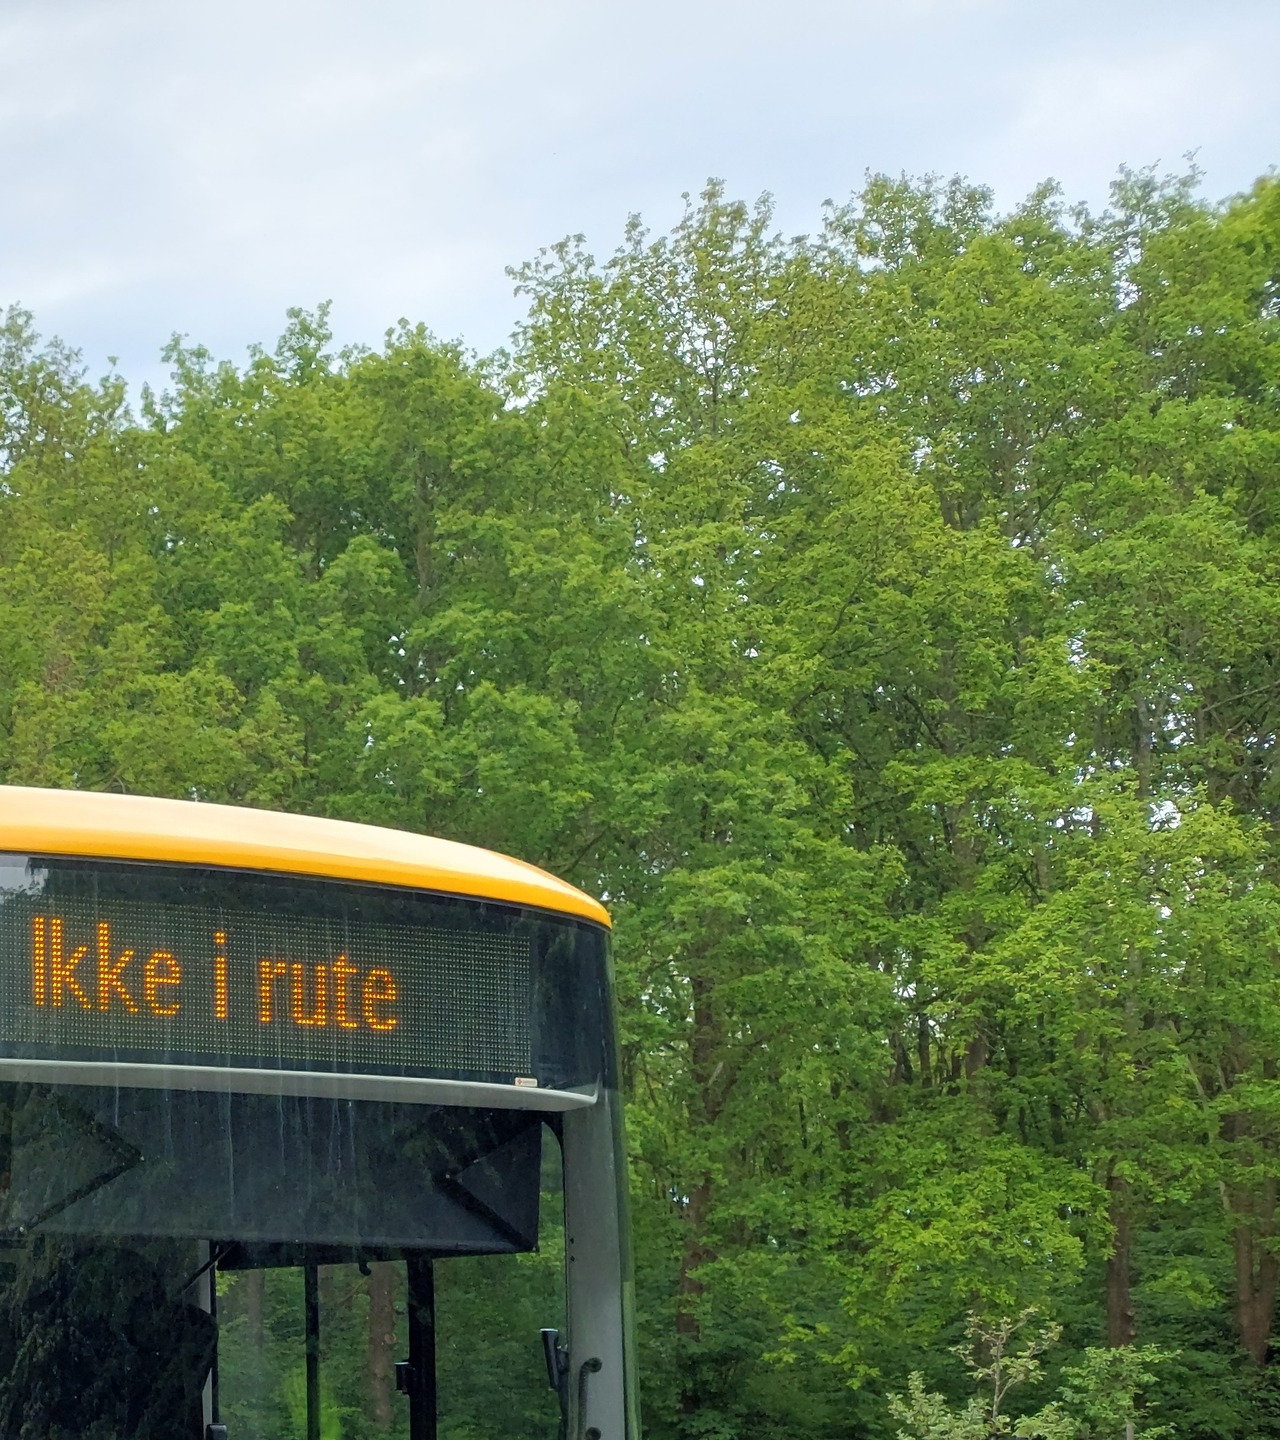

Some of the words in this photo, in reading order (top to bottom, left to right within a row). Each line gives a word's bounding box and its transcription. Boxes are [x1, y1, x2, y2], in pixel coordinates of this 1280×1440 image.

[33, 916, 182, 1016] Ikke
[214, 931, 227, 1019] i
[259, 955, 398, 1031] rute
